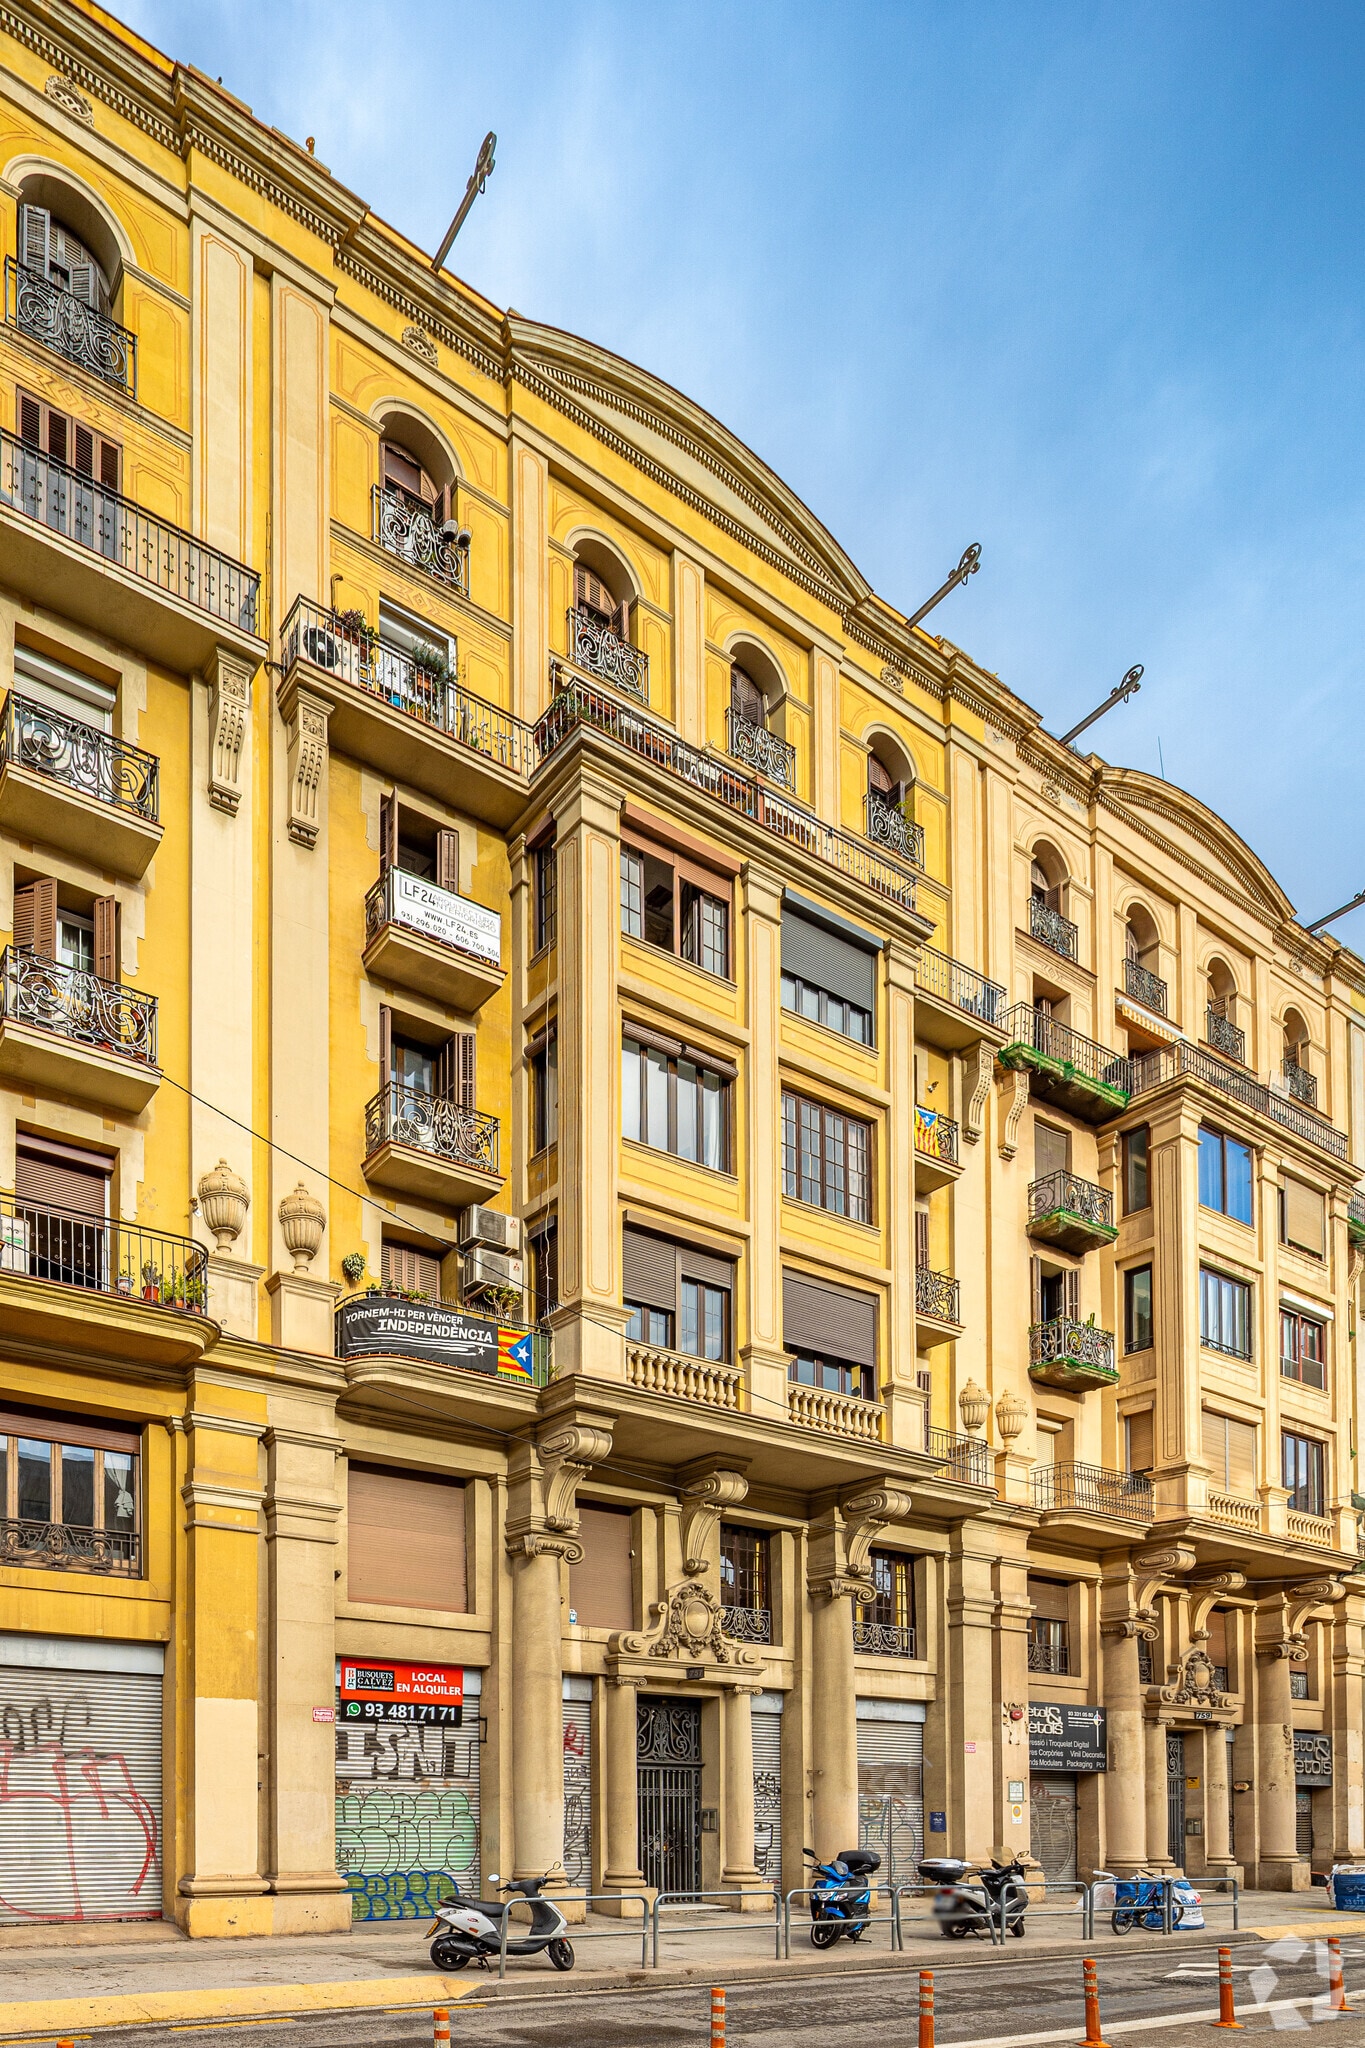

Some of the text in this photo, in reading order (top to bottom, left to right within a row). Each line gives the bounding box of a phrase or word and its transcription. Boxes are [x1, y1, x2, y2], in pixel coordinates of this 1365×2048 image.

[404, 881, 436, 906] LF24
[432, 894, 496, 927] ARQUITECTURA
[401, 911, 447, 935] 931.296.020
[424, 911, 479, 940] WWW.LF24.ES
[346, 1307, 464, 1325] TORNEM-HI PER VÈNCER
[377, 1318, 494, 1344] INDEPENDÈNCIA
[357, 1670, 394, 1680] BUSQUETS
[357, 1677, 394, 1687] GALVEZ
[411, 1672, 447, 1683] LOCAL
[396, 1683, 461, 1696] EN ALQUILER
[365, 1703, 456, 1721] 93 481 71 71
[1049, 1740, 1073, 1748] Troquelat
[1073, 1741, 1089, 1749] Digital
[1070, 1750, 1081, 1758] Vinil
[1082, 1751, 1106, 1759] Decoratiu
[1039, 1759, 1063, 1767] Modulars
[1067, 1760, 1093, 1769] Packaging
